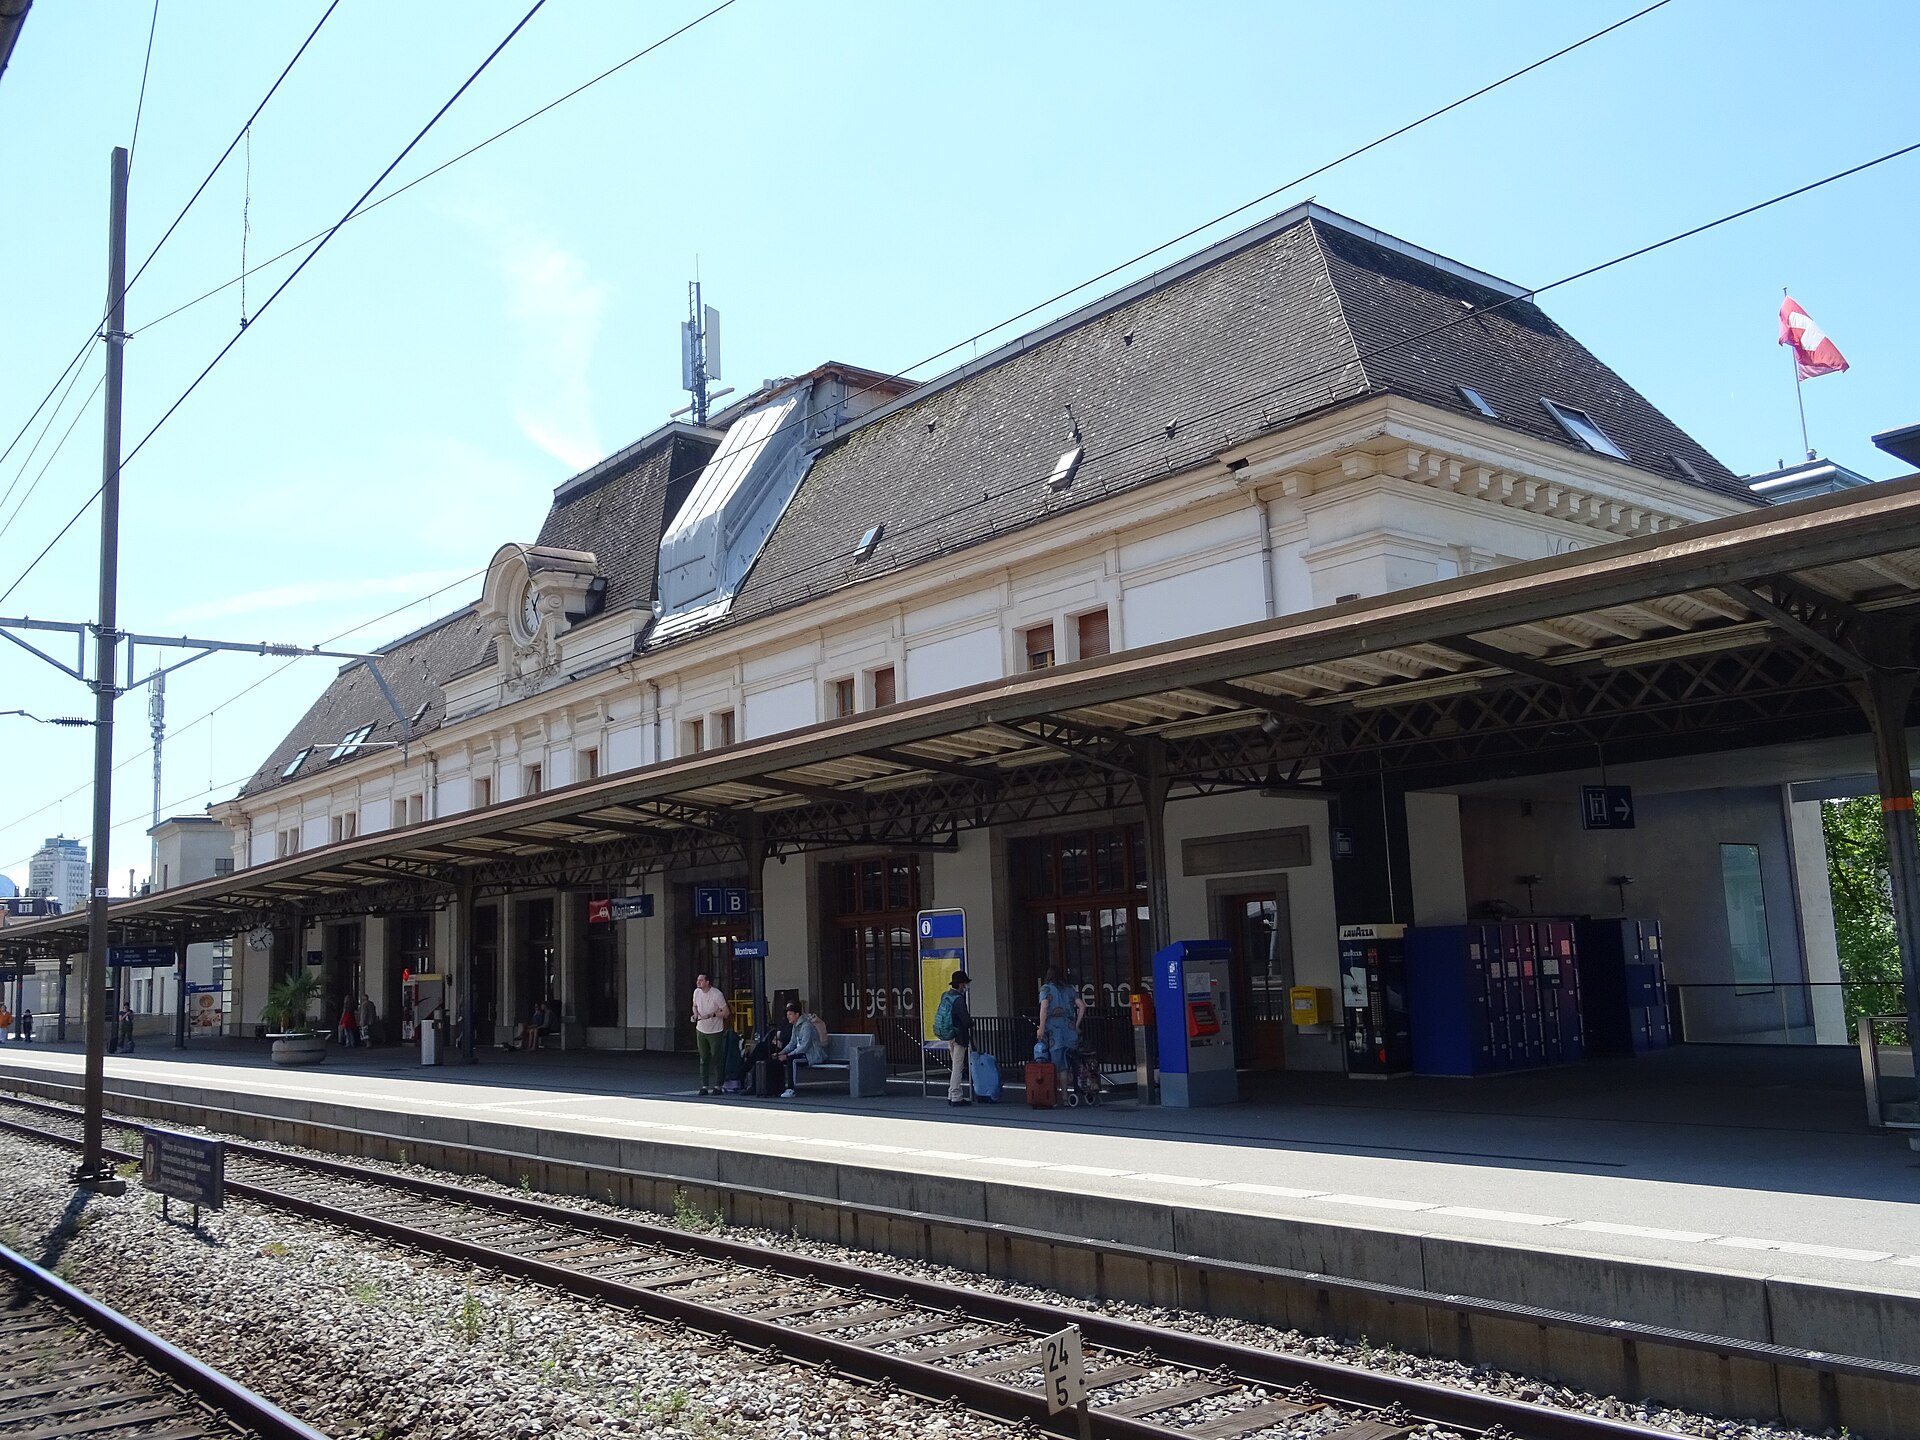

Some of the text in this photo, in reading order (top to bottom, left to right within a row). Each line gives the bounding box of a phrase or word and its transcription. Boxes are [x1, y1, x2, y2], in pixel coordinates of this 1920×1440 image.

[612, 905, 642, 917] Montreux
[707, 896, 713, 911] 1
[730, 896, 741, 911] B
[1344, 927, 1374, 938] LAVAZZA
[734, 947, 759, 956] Montreux
[1048, 1338, 1068, 1372] 24
[1055, 1375, 1068, 1406] 5
